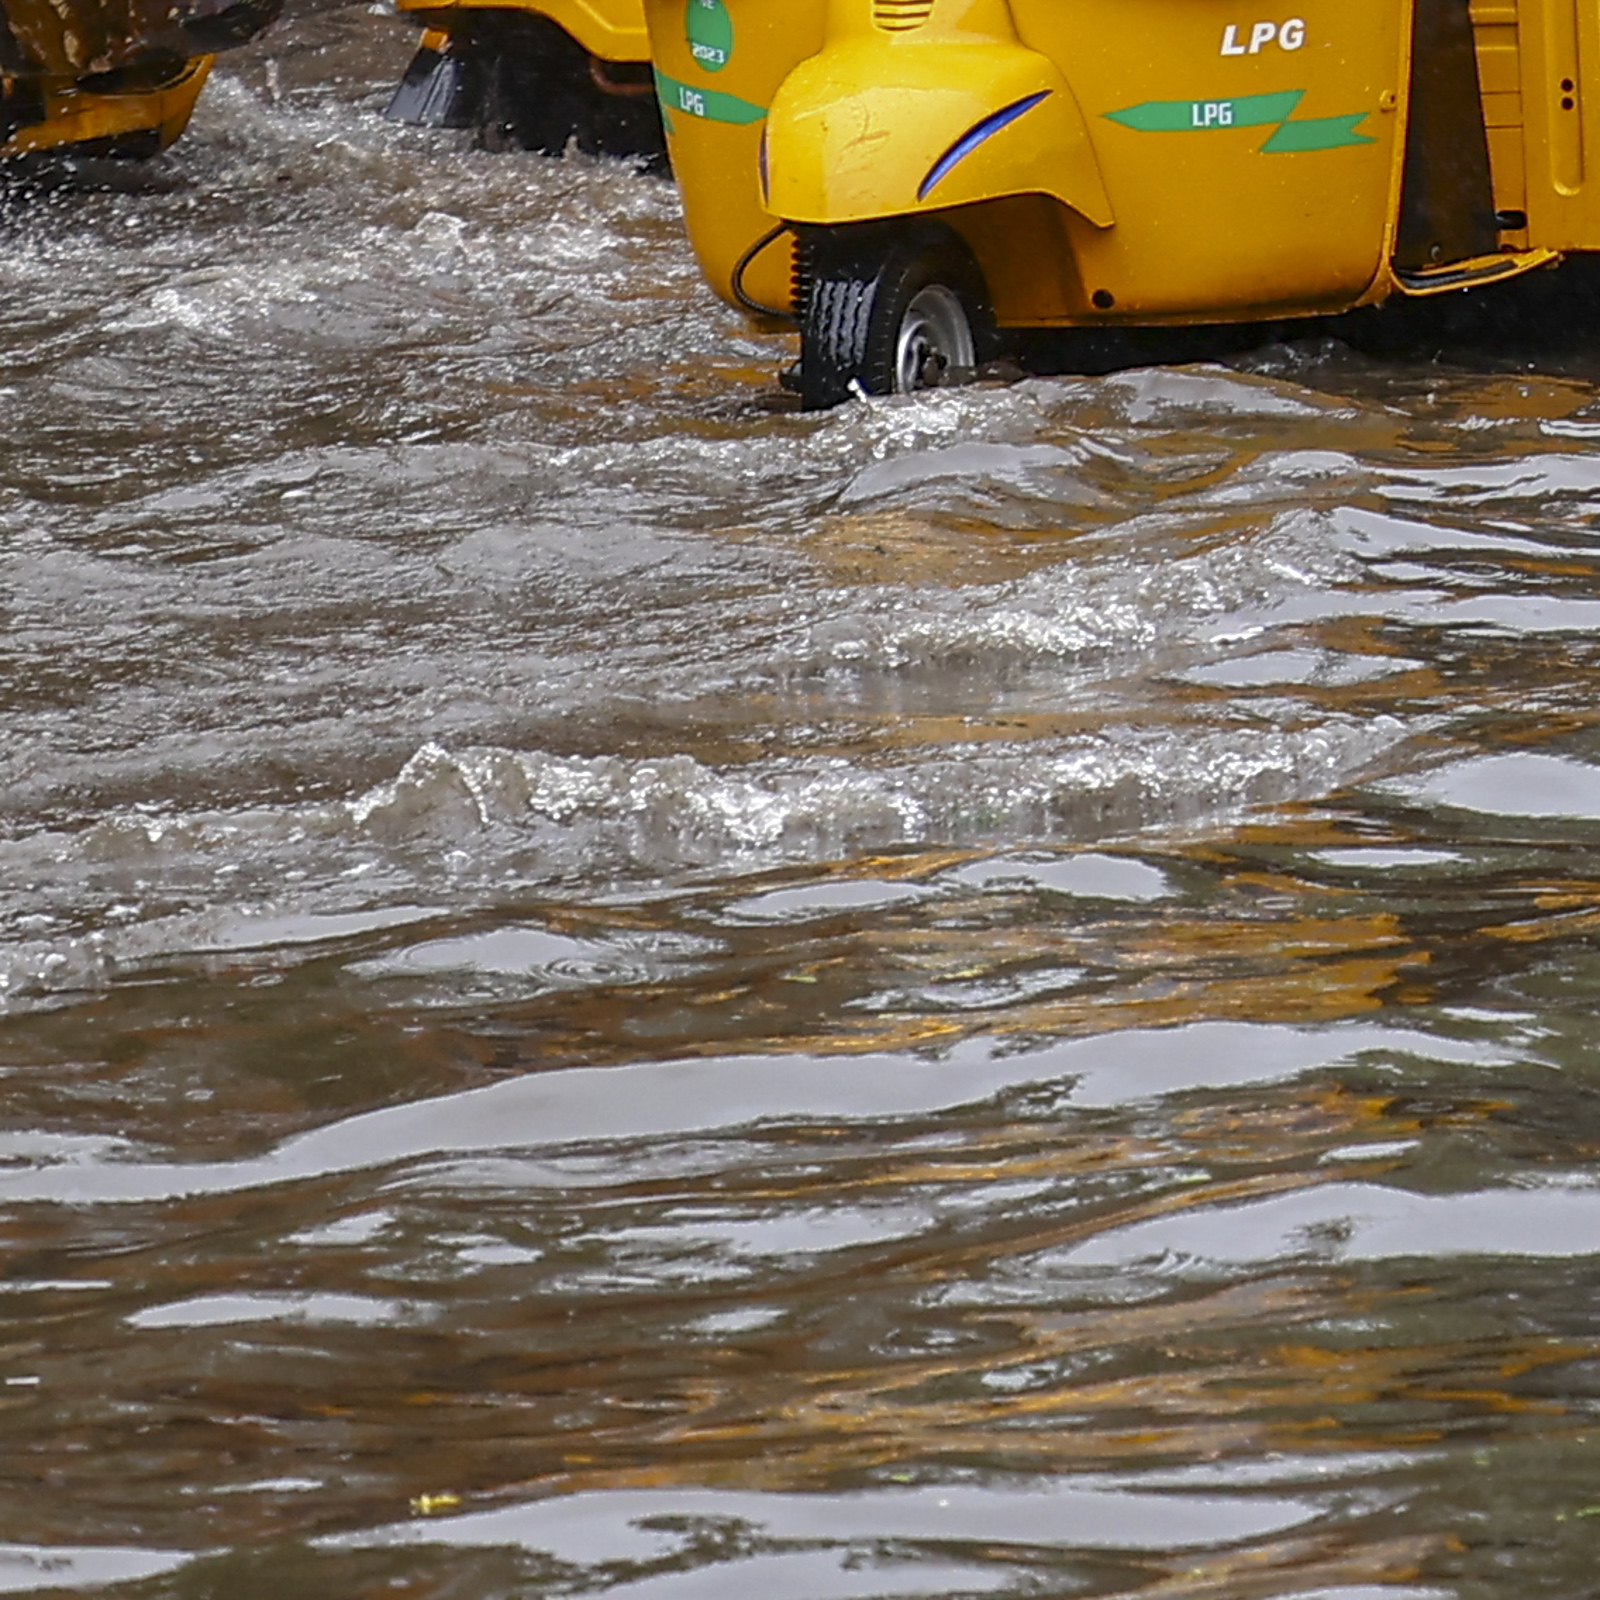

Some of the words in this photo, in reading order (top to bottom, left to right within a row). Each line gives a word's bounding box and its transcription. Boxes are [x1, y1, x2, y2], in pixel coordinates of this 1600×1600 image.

[1220, 18, 1306, 56] LPG
[691, 41, 726, 64] 2023
[679, 86, 705, 117] LPG
[1191, 102, 1233, 127] LPG
